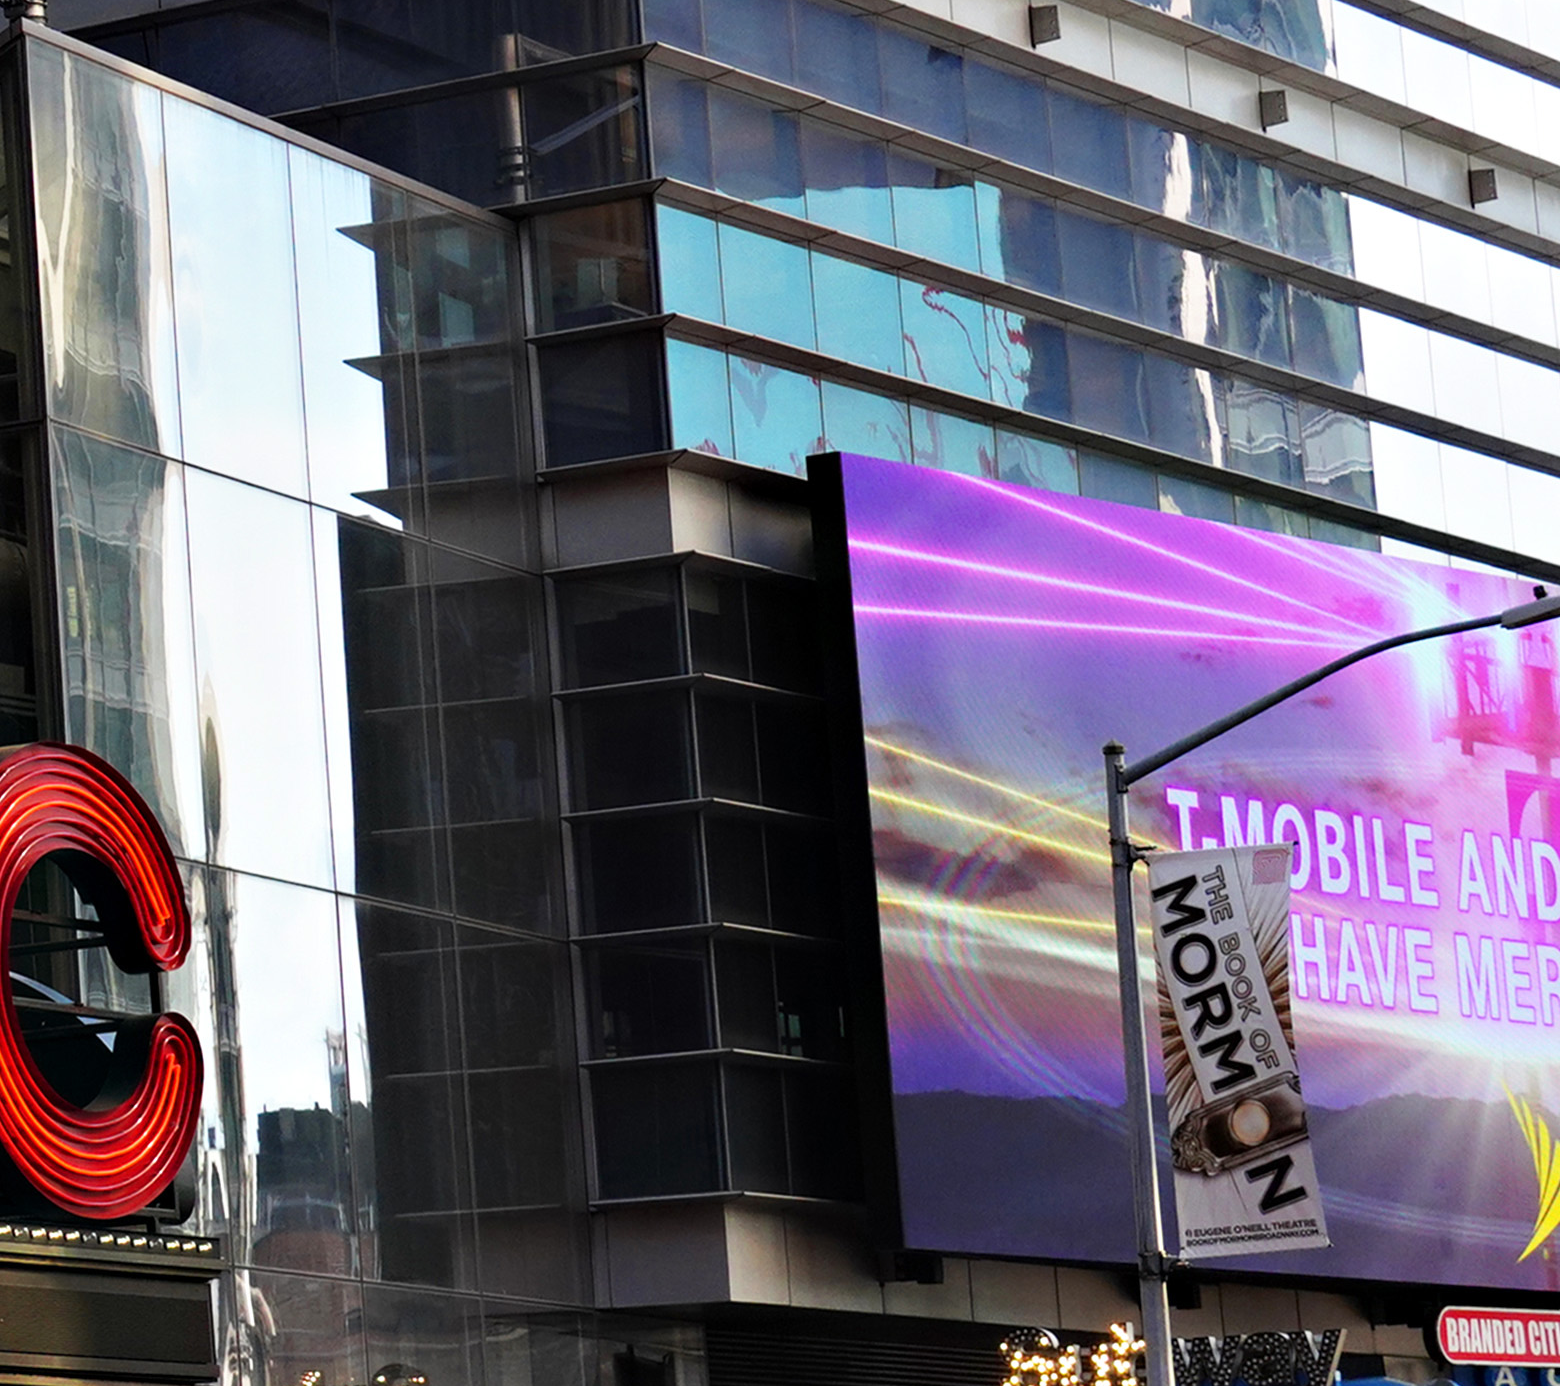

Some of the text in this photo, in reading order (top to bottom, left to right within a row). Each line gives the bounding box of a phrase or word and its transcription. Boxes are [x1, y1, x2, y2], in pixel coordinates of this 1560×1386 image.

[1459, 829, 1560, 922] AND
[1202, 865, 1280, 1071] THE BOOK OF
[1289, 912, 1440, 1014] HAVE
[1193, 1218, 1317, 1238] EUGENE O'NEILL THEATRE
[1445, 1317, 1526, 1356] BRANDED
